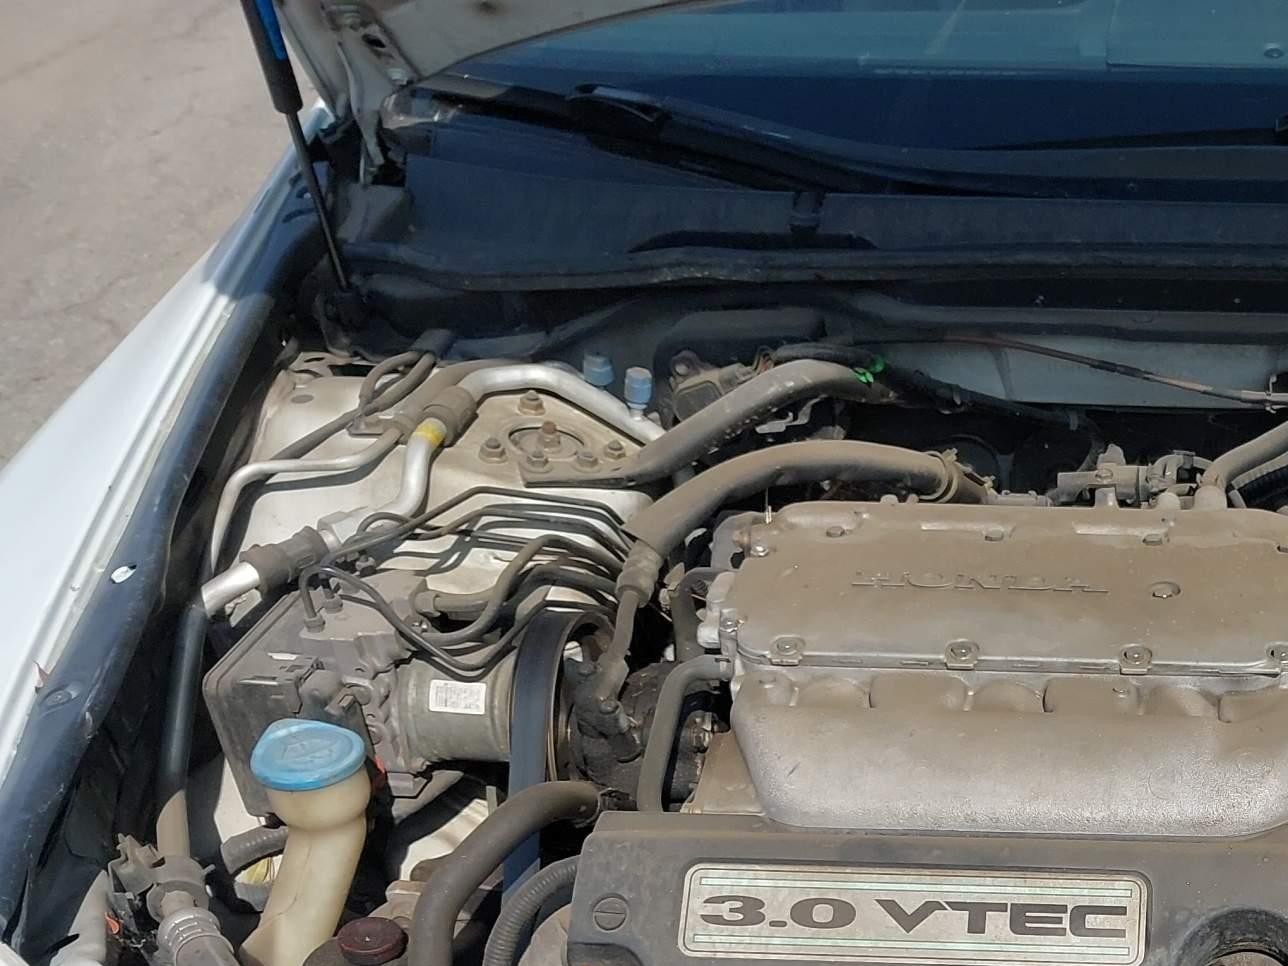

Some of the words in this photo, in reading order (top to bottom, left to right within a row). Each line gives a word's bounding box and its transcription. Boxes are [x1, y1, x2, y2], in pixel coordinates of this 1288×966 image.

[850, 570, 1110, 594] HONDA
[699, 894, 857, 930] 3.0
[874, 898, 1128, 939] VTEC
